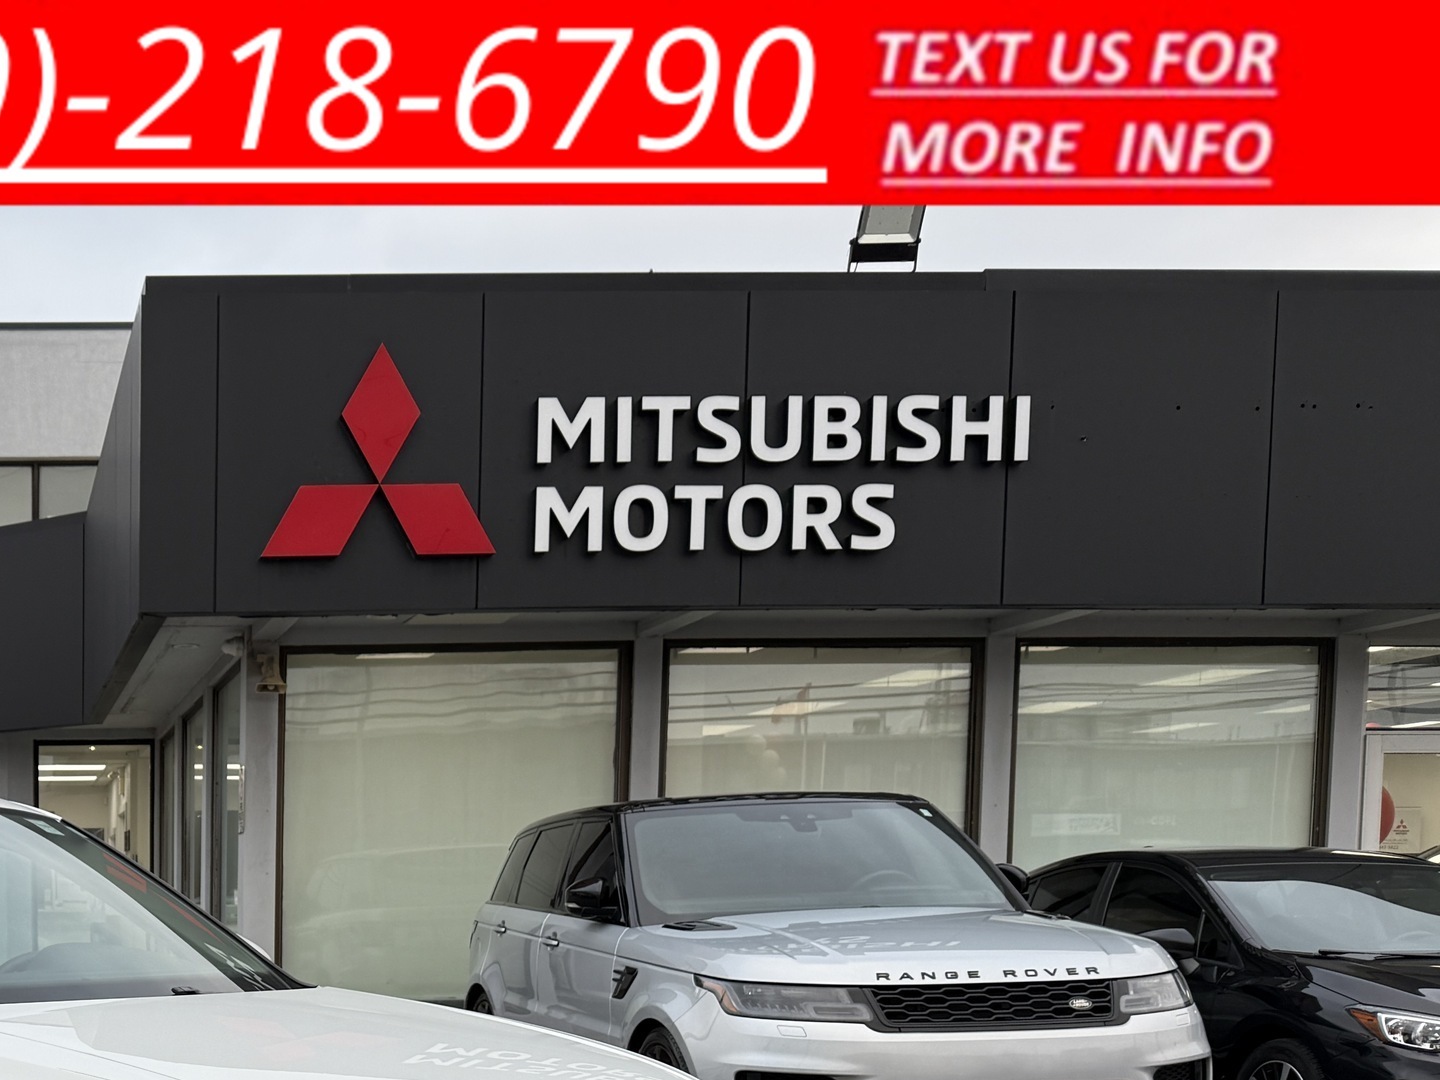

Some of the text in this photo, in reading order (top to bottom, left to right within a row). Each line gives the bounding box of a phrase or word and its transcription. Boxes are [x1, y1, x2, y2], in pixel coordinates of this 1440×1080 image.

[536, 394, 1032, 465] MITSUBISHI
[534, 483, 897, 553] MOTORS
[876, 966, 1100, 981] RANGE ROVER
